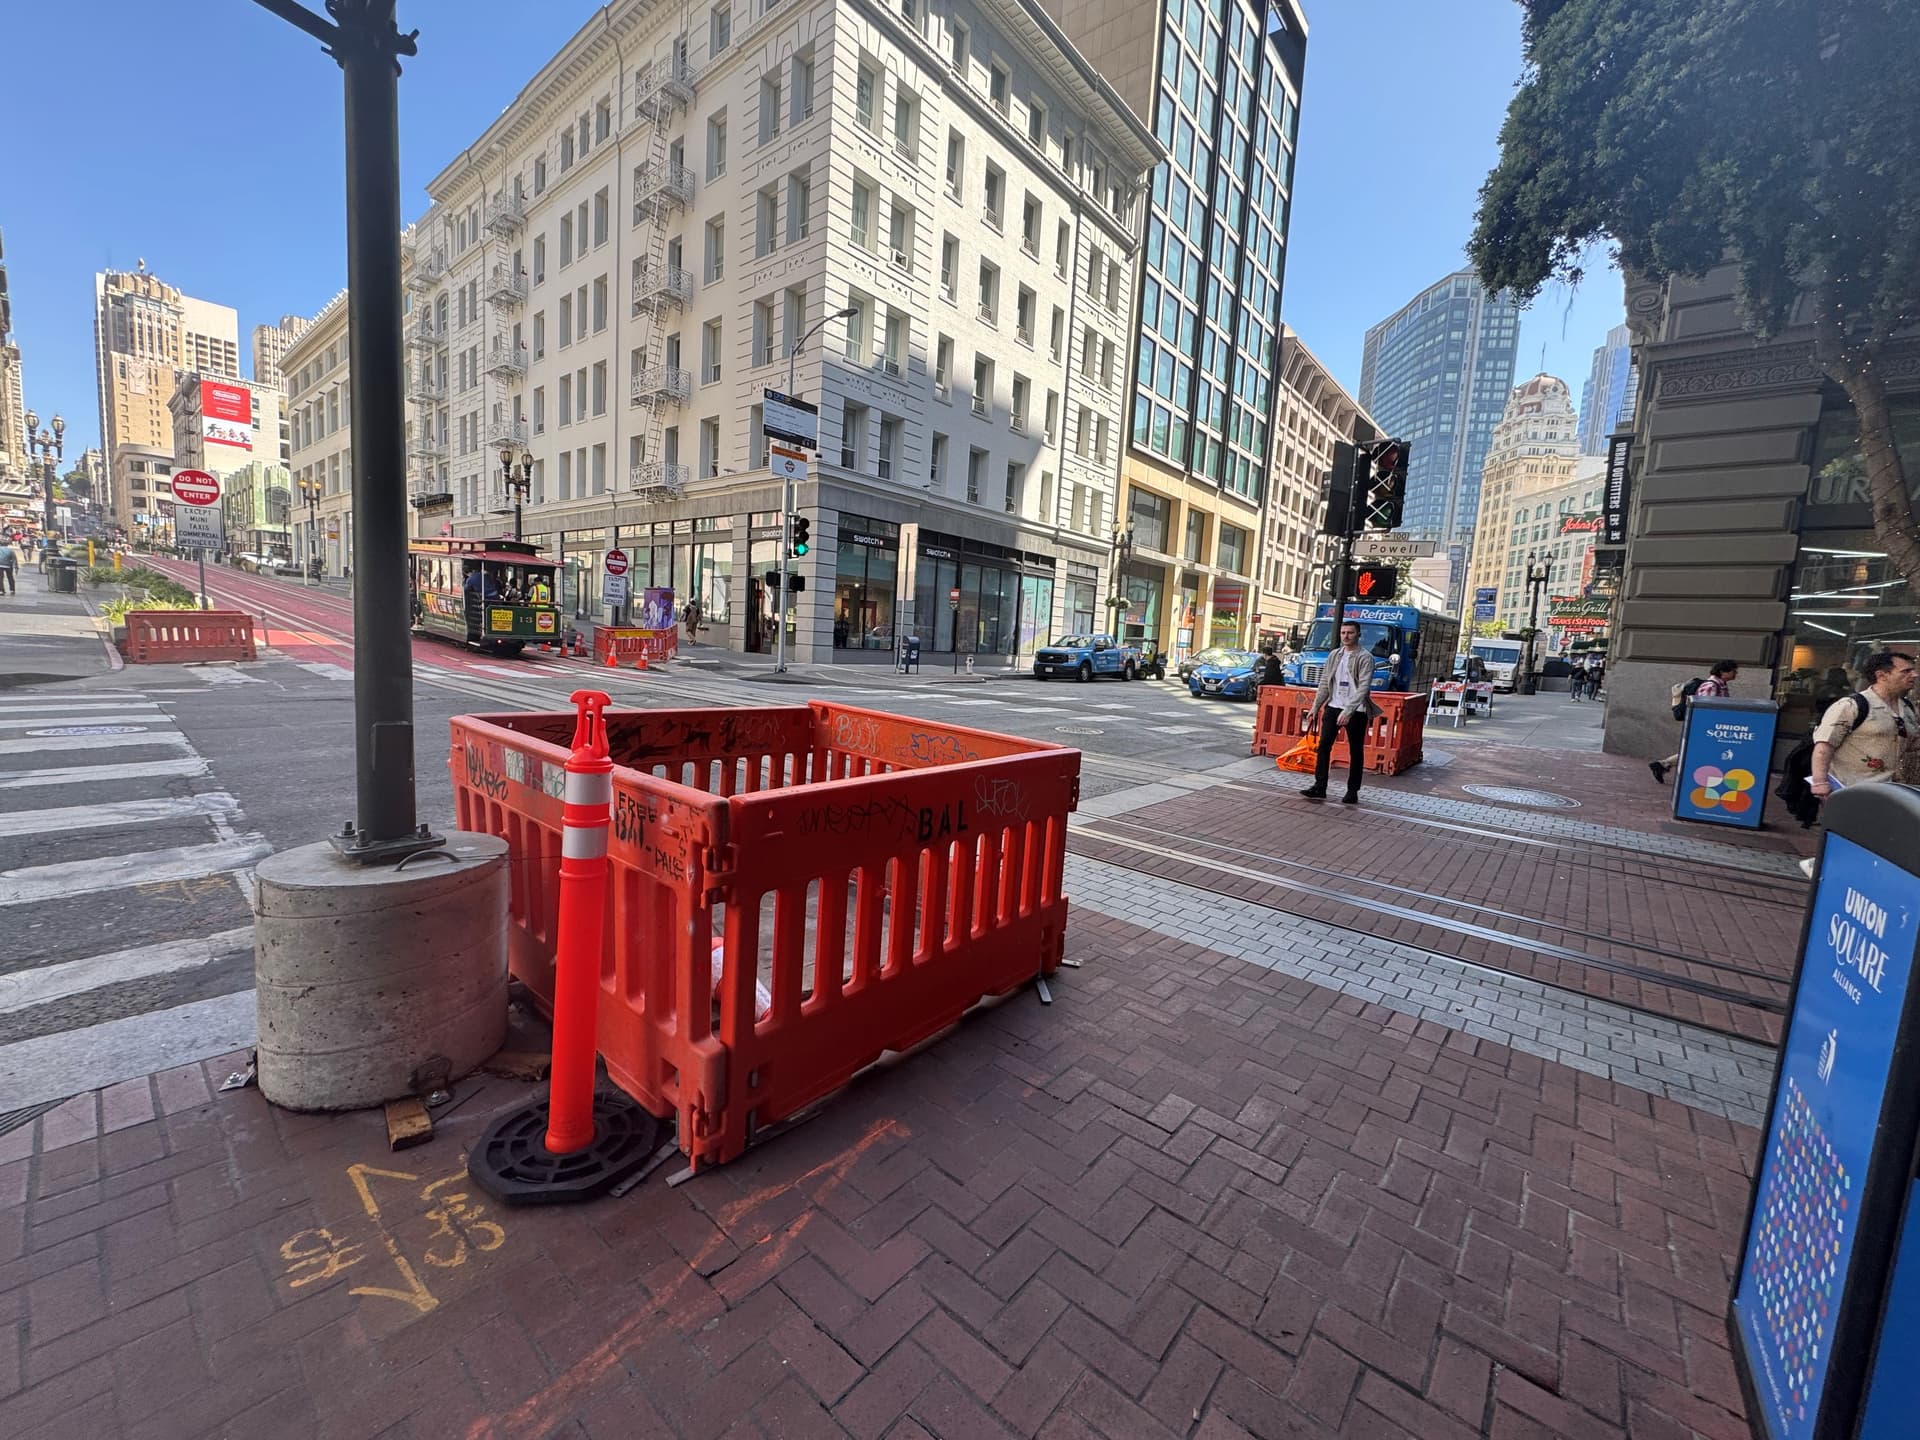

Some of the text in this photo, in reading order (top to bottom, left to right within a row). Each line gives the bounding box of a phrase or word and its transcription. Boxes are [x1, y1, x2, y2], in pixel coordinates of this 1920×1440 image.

[1613, 442, 1627, 466] URBAN
[196, 477, 212, 485] NOT
[1609, 467, 1624, 509] OUTFITTERS
[183, 491, 211, 500] ENTER
[184, 507, 212, 516] EXCEPT
[178, 530, 219, 539] COMMERCIAL
[853, 534, 880, 546] swatch
[926, 548, 948, 558] swatch
[1369, 544, 1419, 554] Powell
[1551, 600, 1609, 616] John's Grill
[1359, 609, 1404, 621] Refresh
[1715, 723, 1749, 732] UNION
[1706, 729, 1756, 741] SQUARE
[918, 799, 969, 841] BAL
[1844, 887, 1888, 939] UNION
[1827, 913, 1890, 994] SQUARE
[1832, 968, 1862, 1005] ALLIANCE
